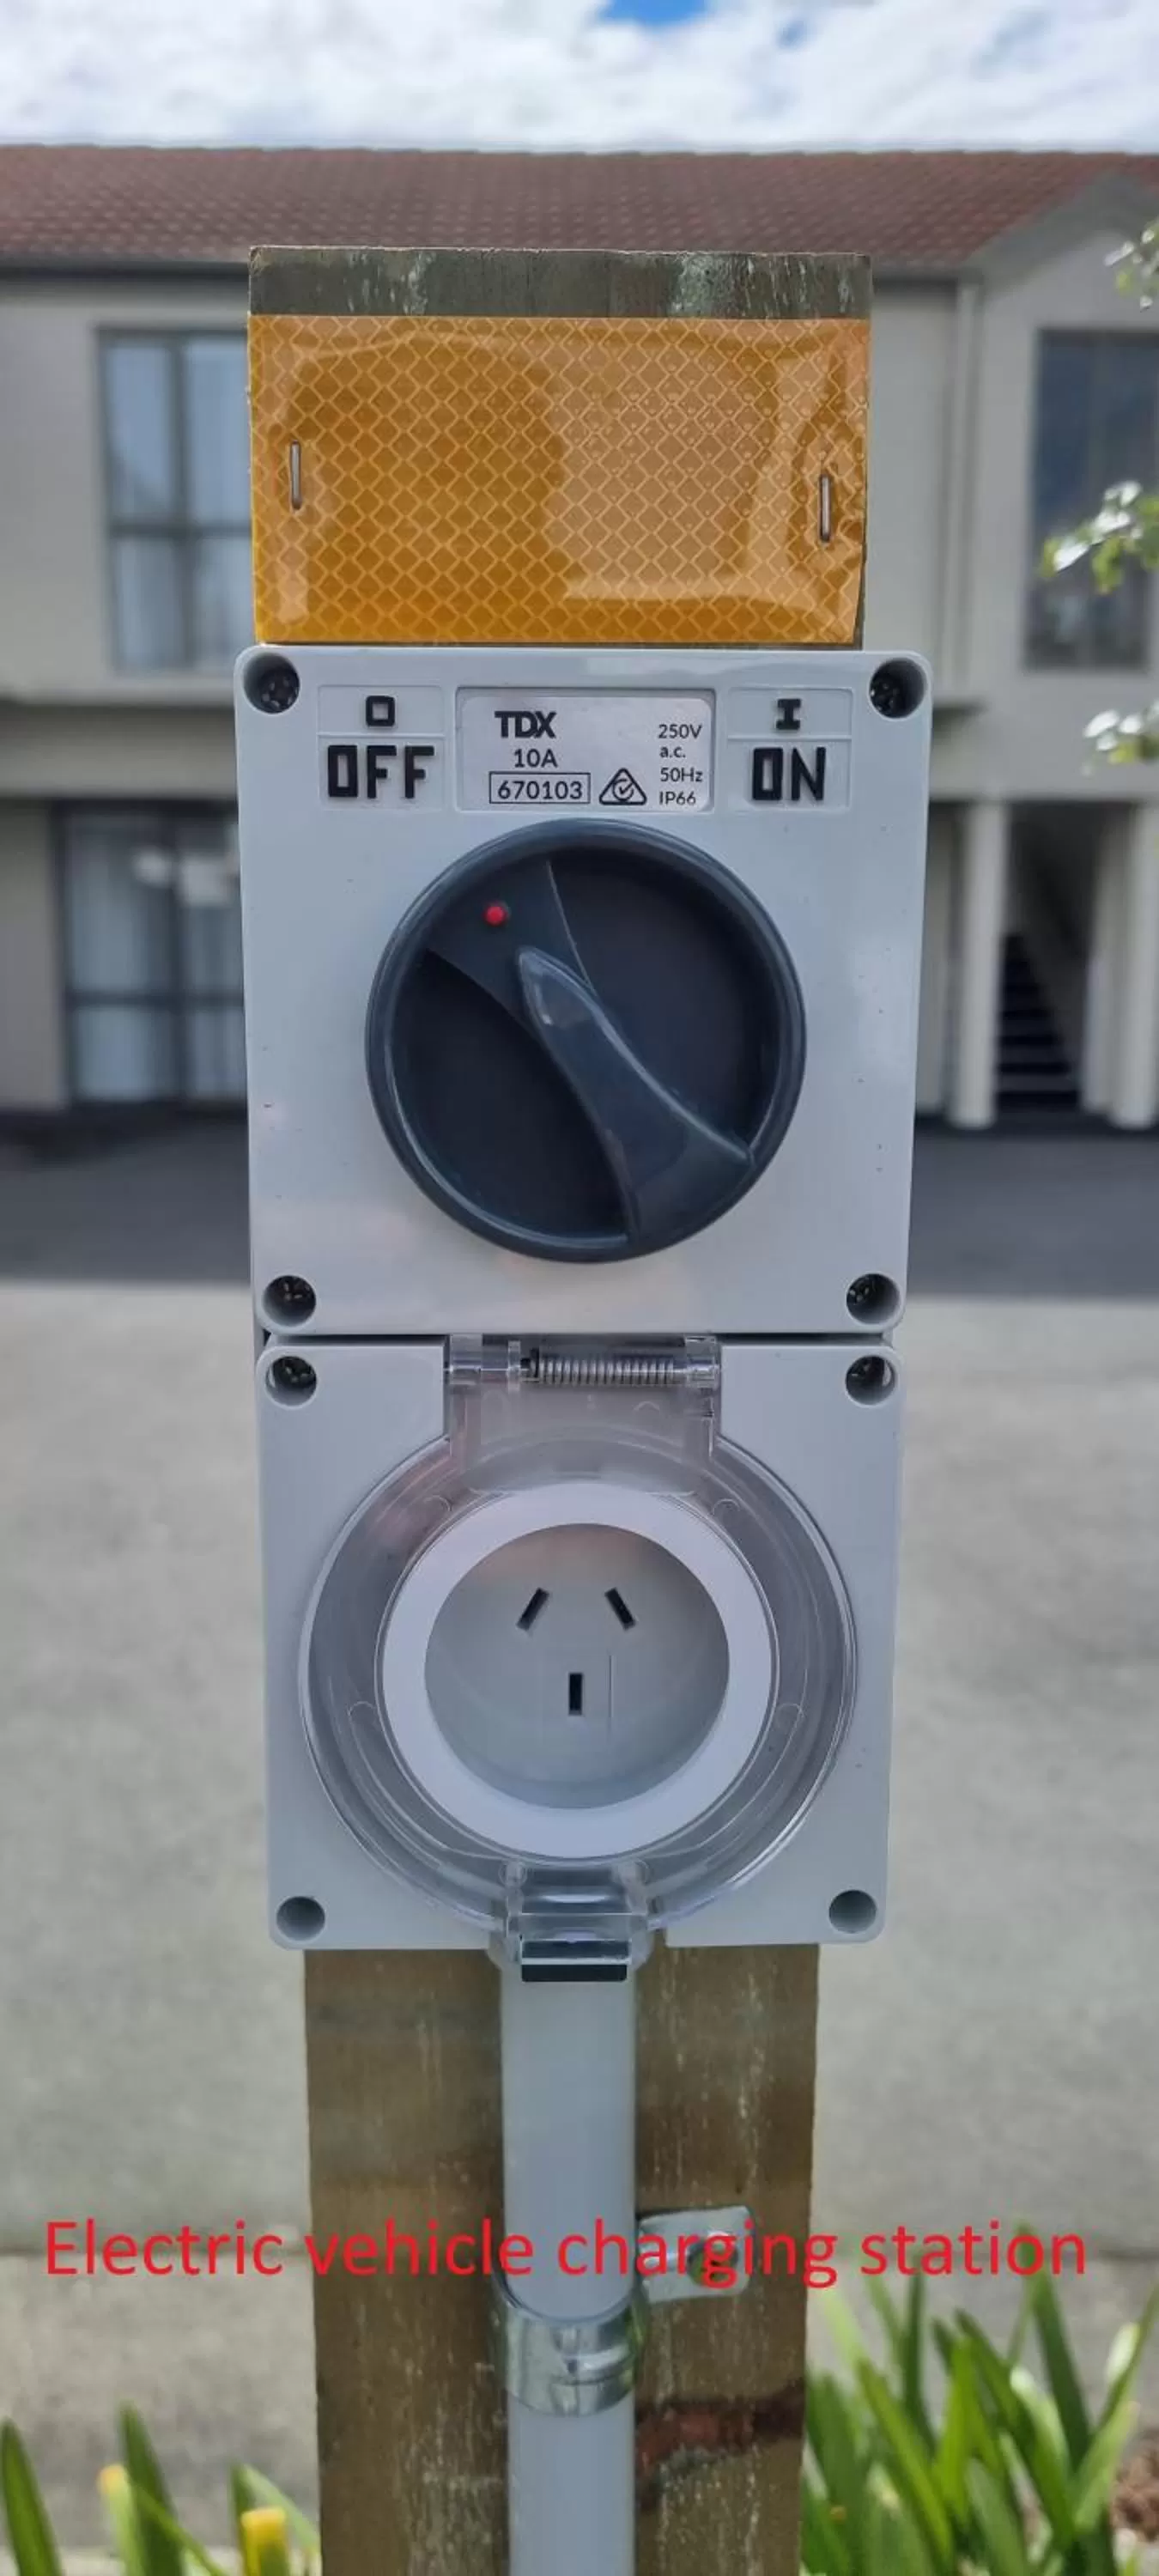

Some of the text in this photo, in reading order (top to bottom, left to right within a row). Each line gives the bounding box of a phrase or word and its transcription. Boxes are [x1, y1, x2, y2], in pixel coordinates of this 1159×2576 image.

[495, 710, 557, 739] TDX
[658, 724, 702, 740] 250V
[513, 748, 558, 769] 10A
[658, 745, 687, 759] a.c.
[327, 744, 435, 799] OFF
[659, 767, 703, 783] 50Hz
[752, 745, 827, 801] ON
[497, 780, 583, 800] 670103
[658, 790, 697, 806] IP66
